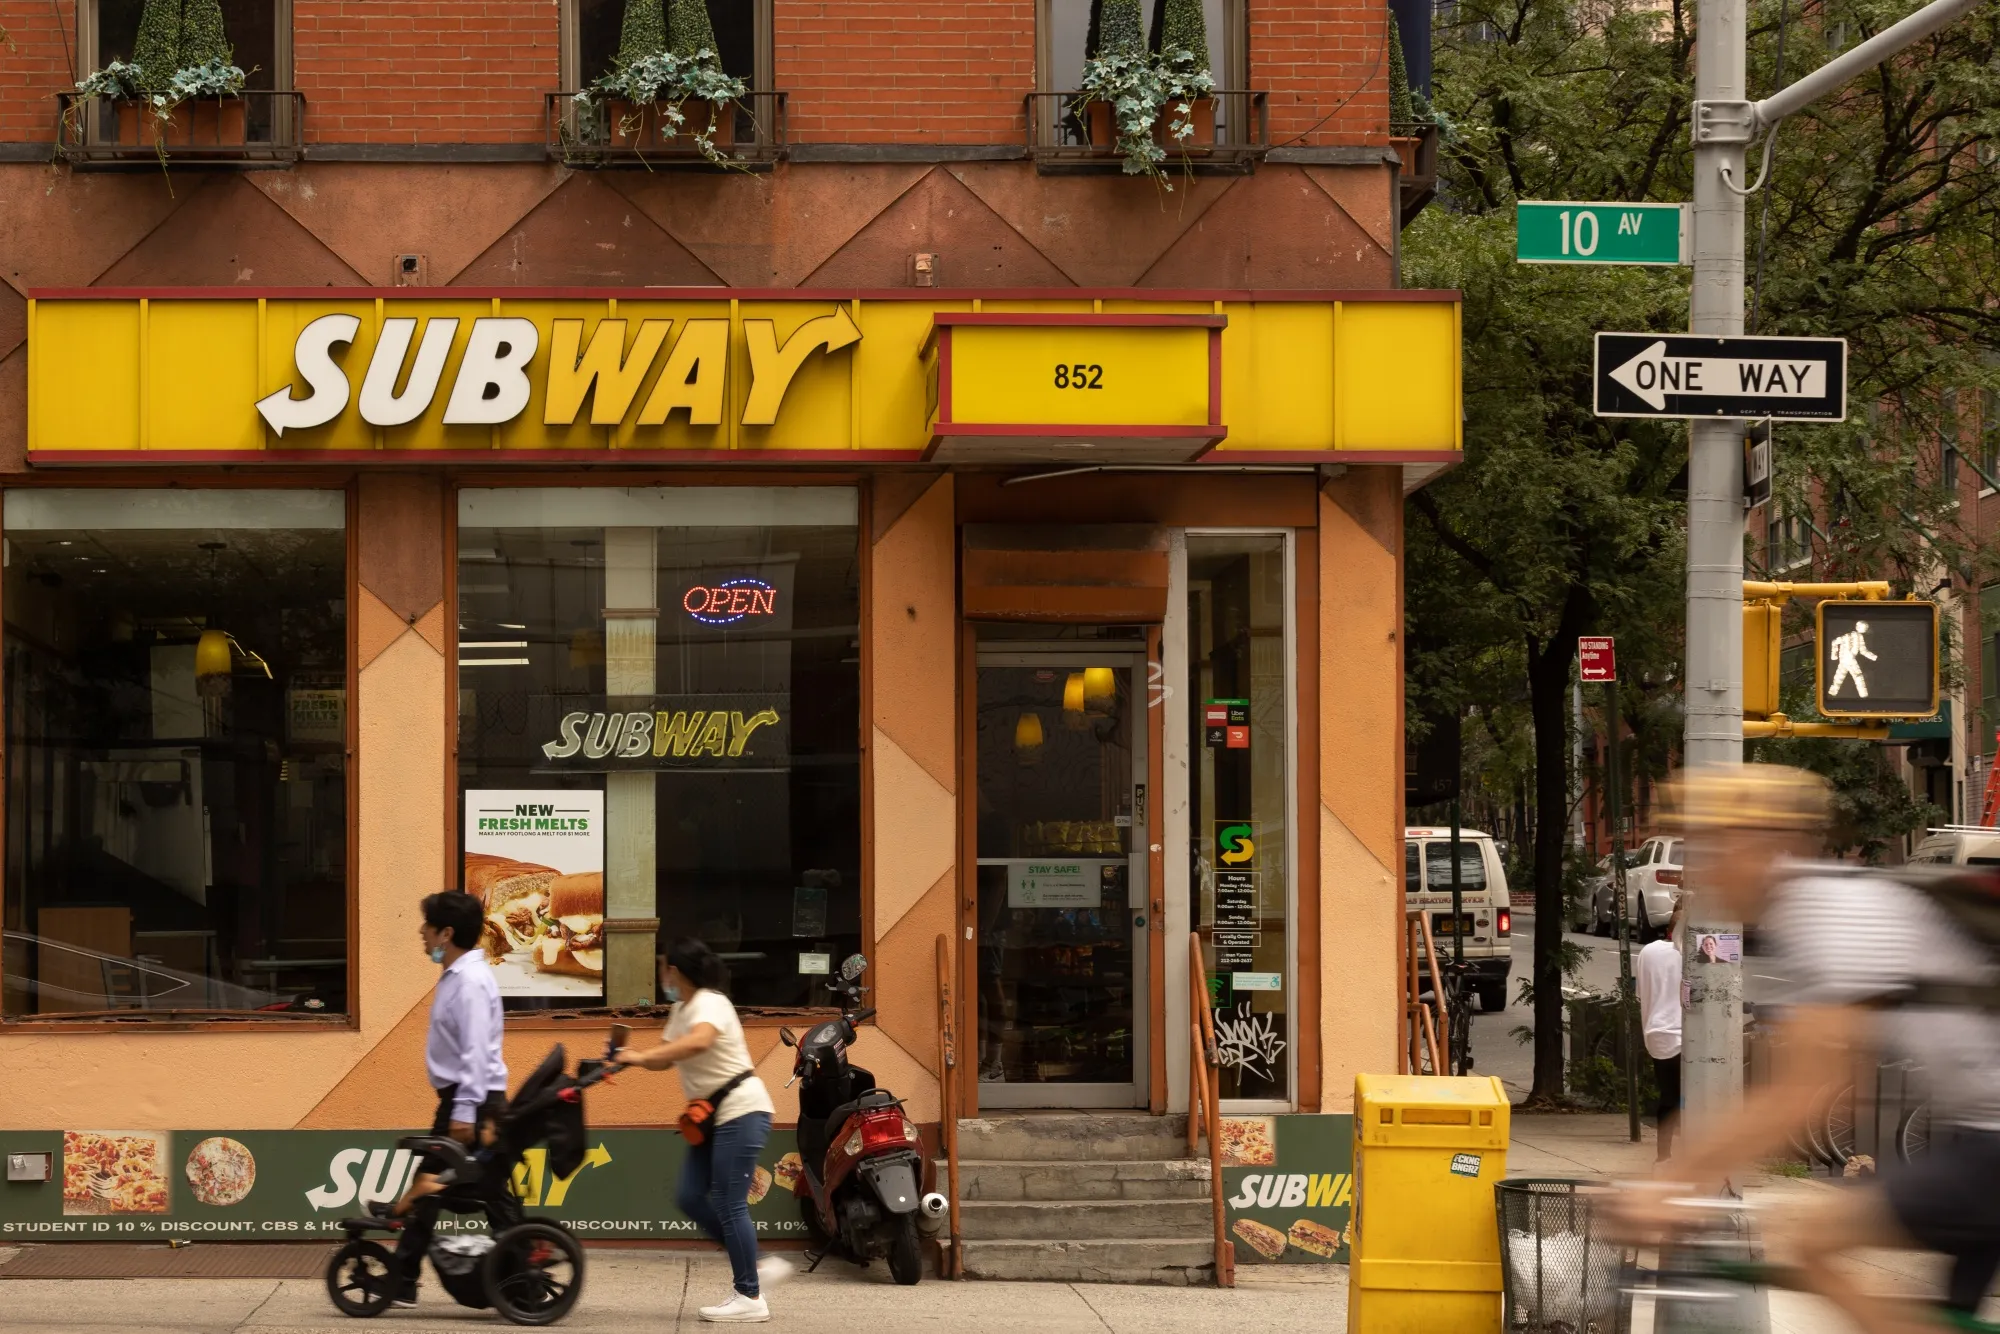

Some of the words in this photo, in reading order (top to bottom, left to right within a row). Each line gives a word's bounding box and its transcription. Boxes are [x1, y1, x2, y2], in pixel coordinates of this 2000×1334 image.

[1559, 211, 1599, 256] 10
[1618, 212, 1643, 236] AV
[254, 303, 864, 439] SUBWAY
[1054, 363, 1103, 390] 852
[1635, 360, 1703, 391] ONE
[1739, 363, 1812, 394] WAY
[683, 586, 777, 614] OPEN
[1588, 642, 1609, 650] STANDING
[294, 700, 338, 710] FRESH
[294, 711, 338, 721] MELTS
[1919, 715, 1943, 723] UDIES
[541, 706, 781, 761] SUBWAY
[515, 804, 554, 817] NEW
[478, 818, 532, 830] FRESH
[535, 818, 588, 830] MELTS
[1028, 866, 1051, 874] STAY
[1054, 866, 1081, 874] SAFE!
[1453, 1154, 1481, 1166] FCKNG
[1451, 1162, 1479, 1174] BNGRZ
[305, 1142, 613, 1212] SUAY
[1228, 1173, 1352, 1211] SUBWA
[3, 1222, 88, 1232] STUDENT
[92, 1222, 110, 1232] ID
[115, 1221, 135, 1232] 10
[139, 1221, 156, 1232] %
[160, 1221, 256, 1233] DISCOUNT,
[261, 1221, 299, 1232] CBS
[304, 1221, 317, 1231] &
[434, 1220, 489, 1231] MPLOY
[560, 1220, 654, 1232] DISCOUNT,
[659, 1220, 697, 1231] TAXI
[774, 1221, 809, 1231] 10%
